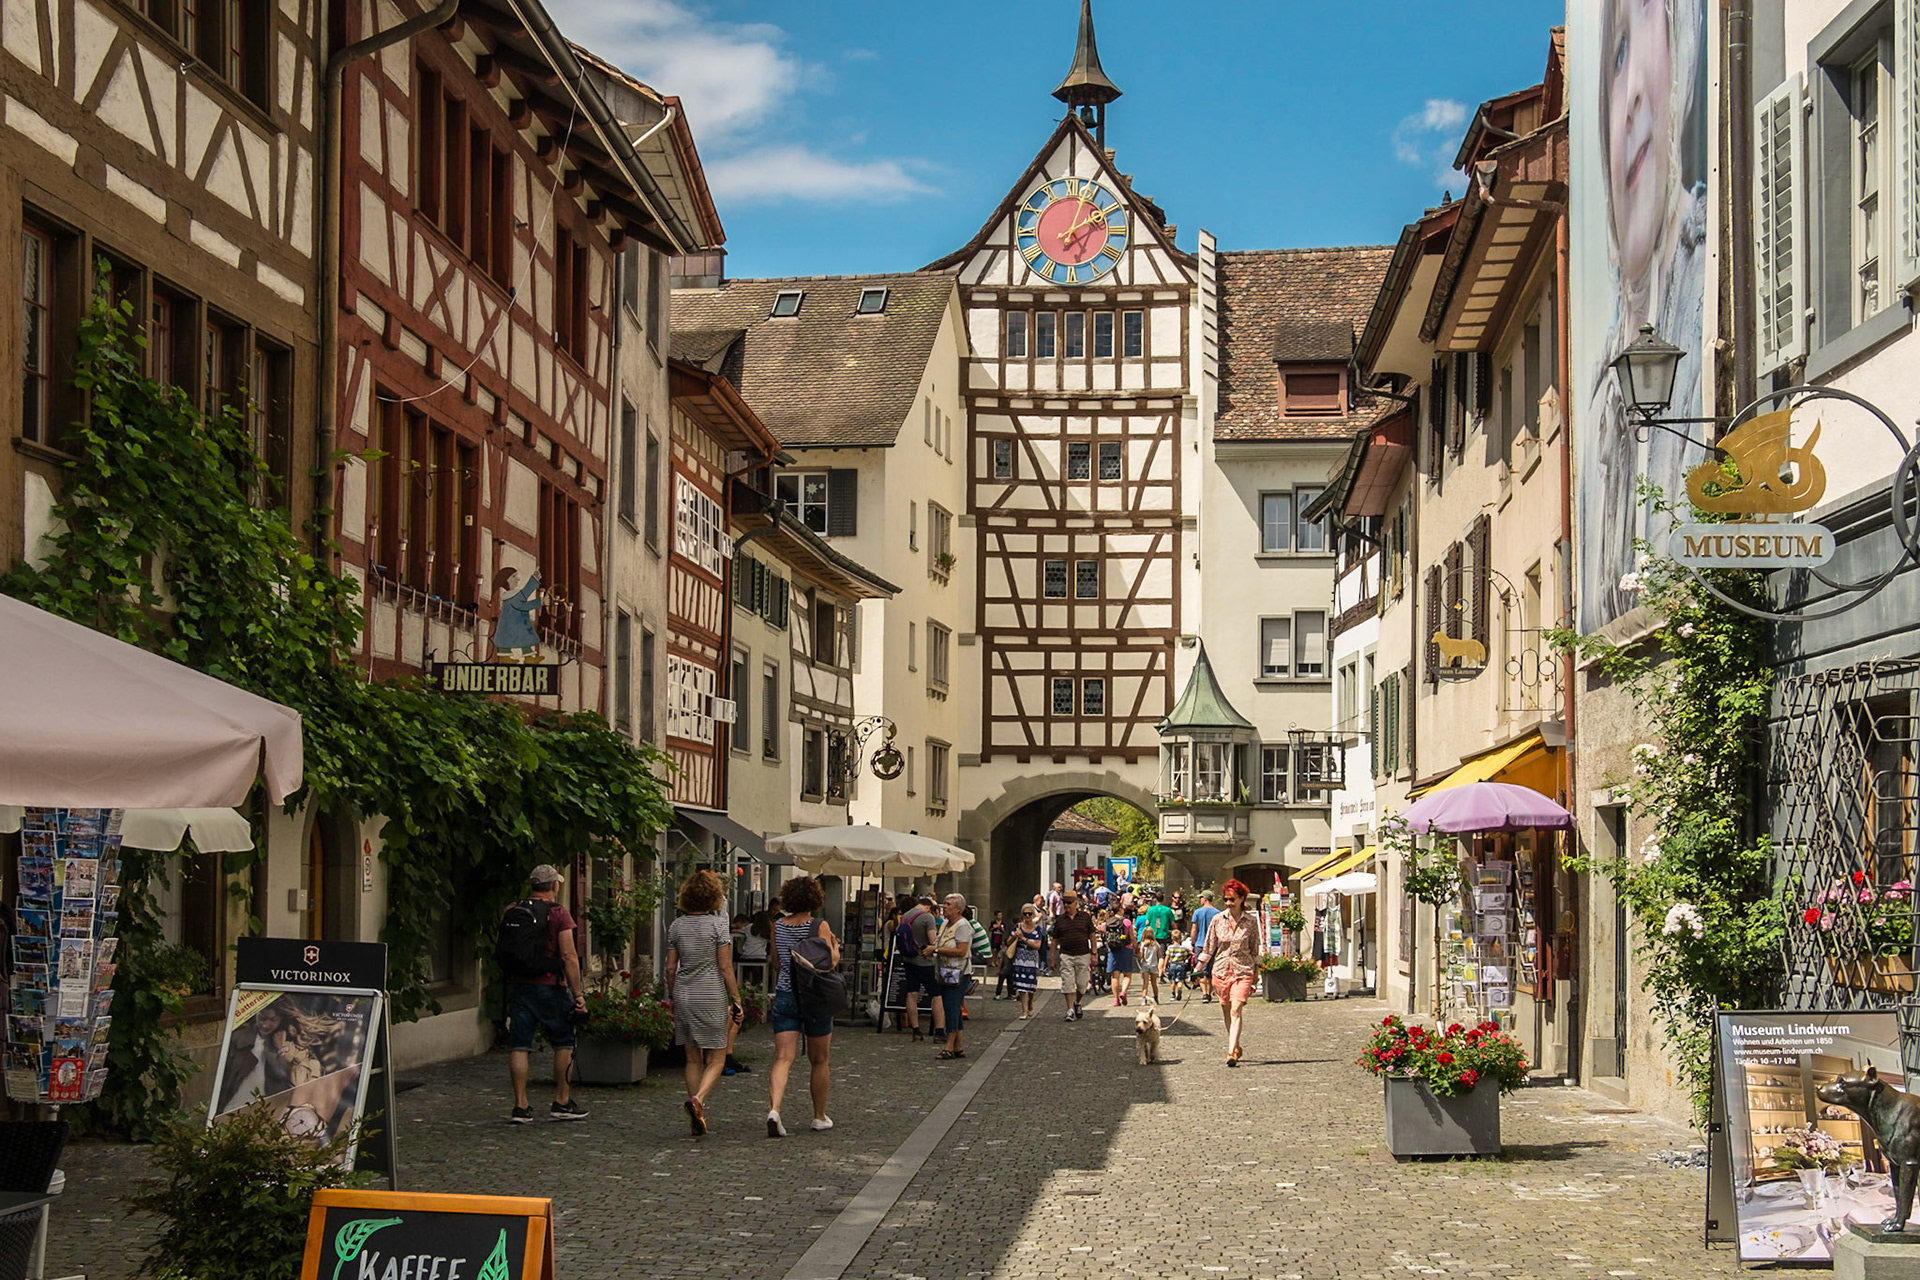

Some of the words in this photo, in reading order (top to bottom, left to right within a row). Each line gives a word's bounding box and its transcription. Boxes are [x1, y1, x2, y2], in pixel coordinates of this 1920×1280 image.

[1683, 534, 1823, 558] MUSEUM
[443, 665, 548, 693] UNDERBAR
[271, 969, 351, 983] VICTORINOX
[237, 990, 254, 1004] Hier
[234, 991, 269, 1018] Batterien
[1732, 1024, 1784, 1036] Museum
[1788, 1023, 1850, 1036] Lindwurm
[1733, 1038, 1760, 1046] Wohnen
[1761, 1038, 1774, 1046] und
[1774, 1037, 1803, 1046] Arbeiten
[1817, 1037, 1833, 1045] 1850
[1733, 1047, 1823, 1055] www.museum-lindwurm.ch
[1784, 1057, 1797, 1065] Uhr
